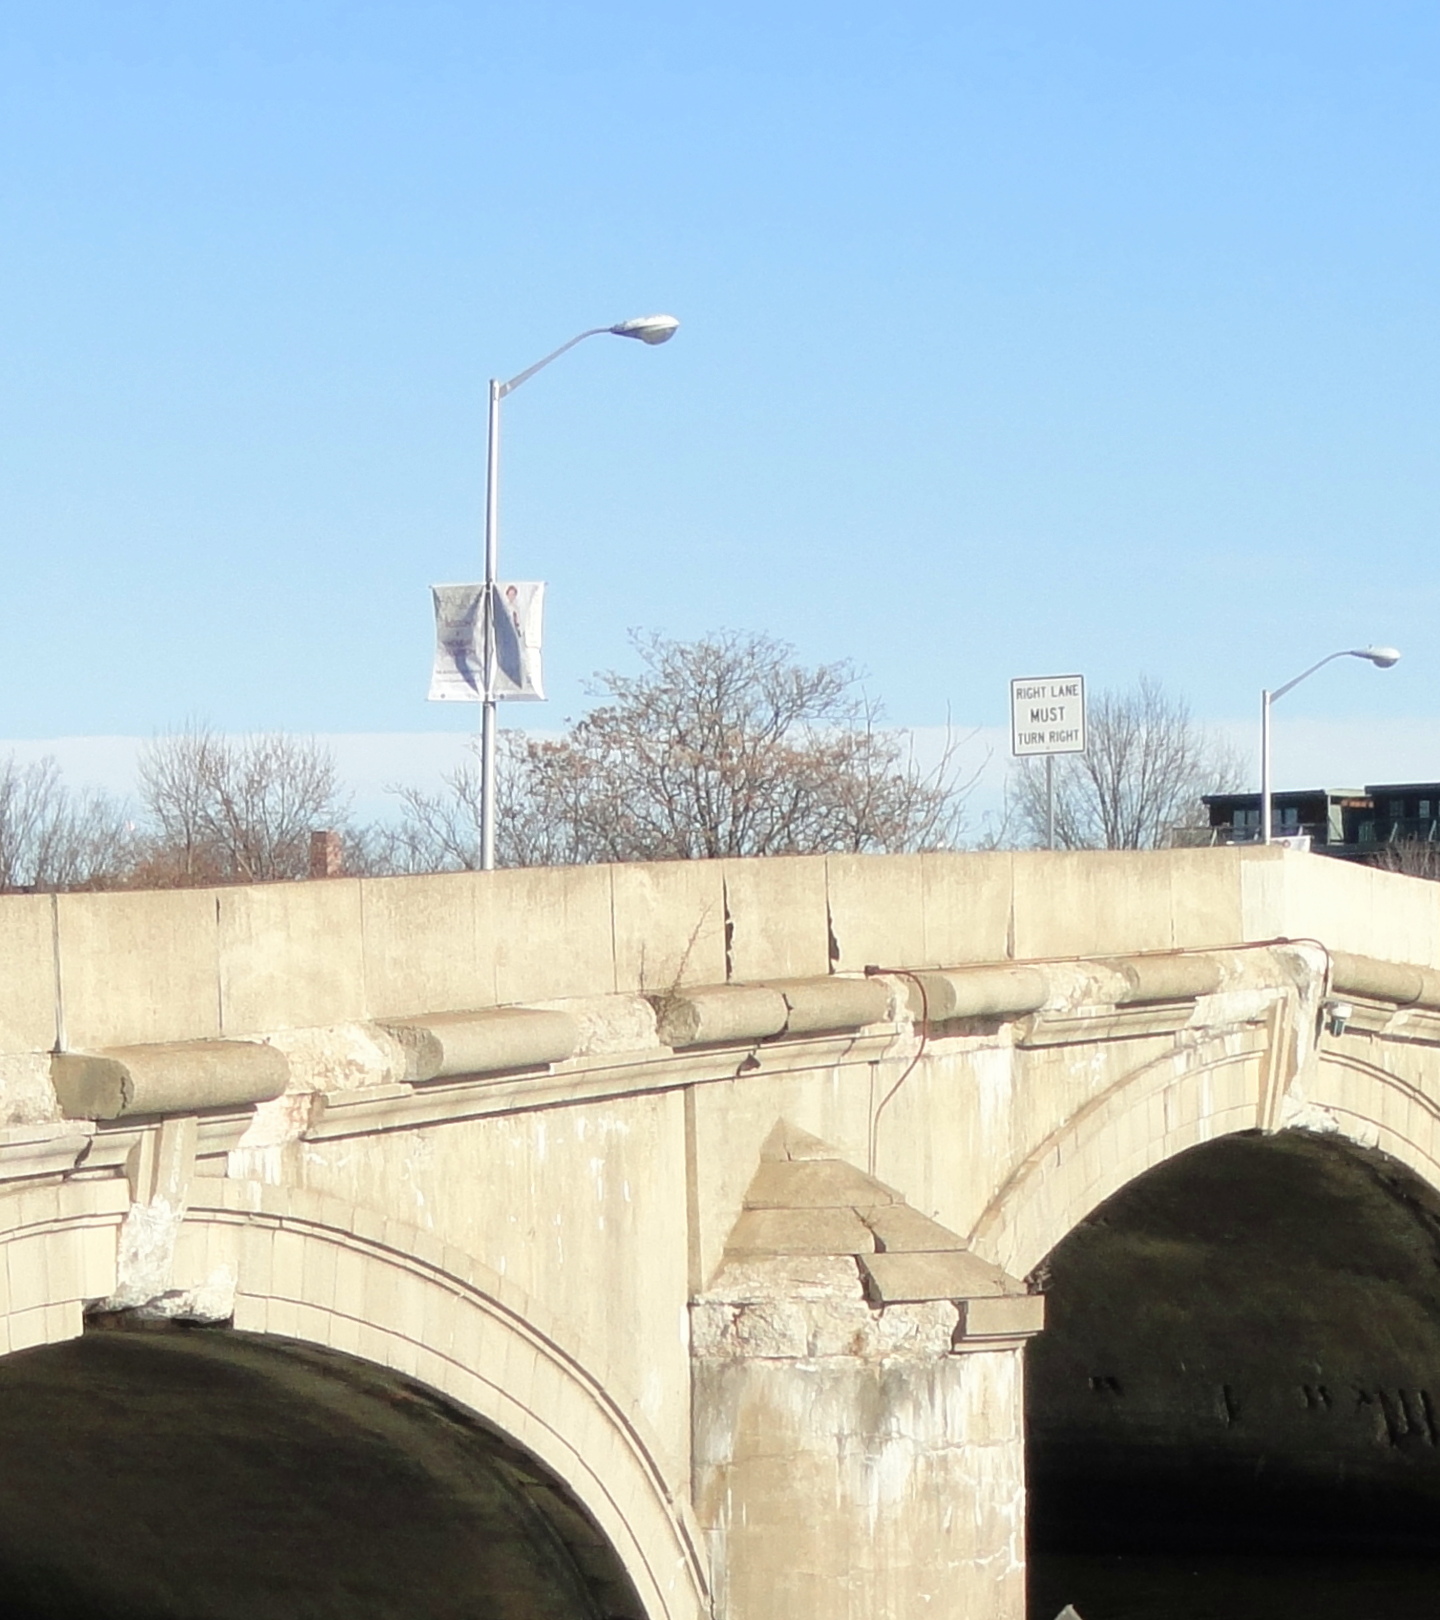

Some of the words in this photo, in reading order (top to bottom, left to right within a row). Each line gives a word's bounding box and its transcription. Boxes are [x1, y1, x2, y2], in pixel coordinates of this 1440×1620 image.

[1016, 686, 1046, 700] RIGHT
[1051, 684, 1079, 698] LANE
[1030, 706, 1065, 723] MUST
[1018, 731, 1045, 745] TURN
[1049, 729, 1079, 743] RIGHT
